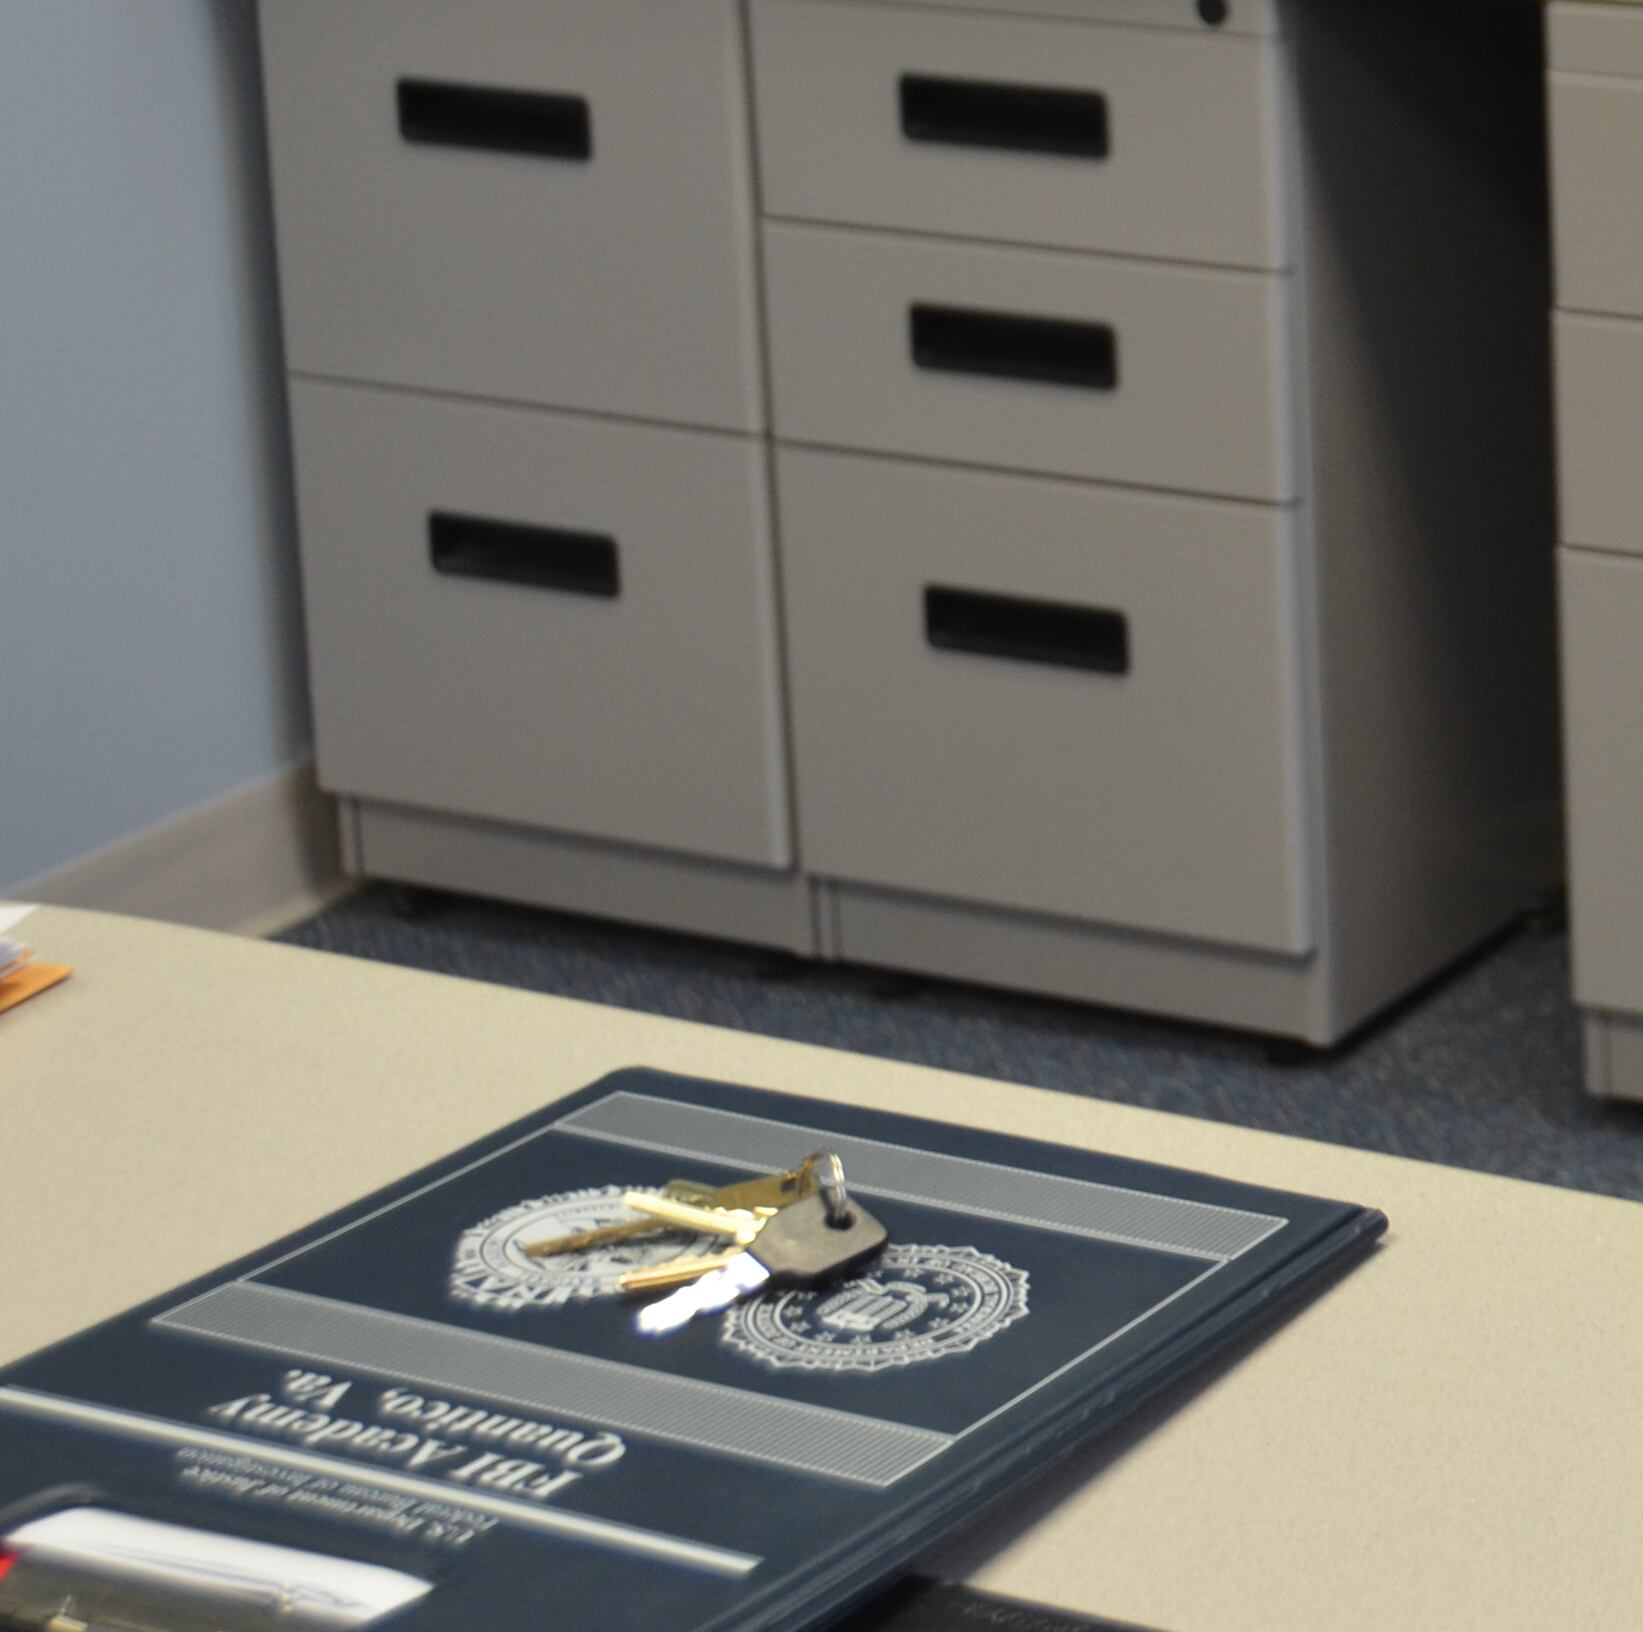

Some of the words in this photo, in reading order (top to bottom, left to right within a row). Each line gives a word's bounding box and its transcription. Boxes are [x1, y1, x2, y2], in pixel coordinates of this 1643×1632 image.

[280, 1368, 355, 1412] Va.
[205, 1392, 465, 1469] Academy
[377, 1386, 628, 1469] Quantico,
[446, 1450, 584, 1500] FBI
